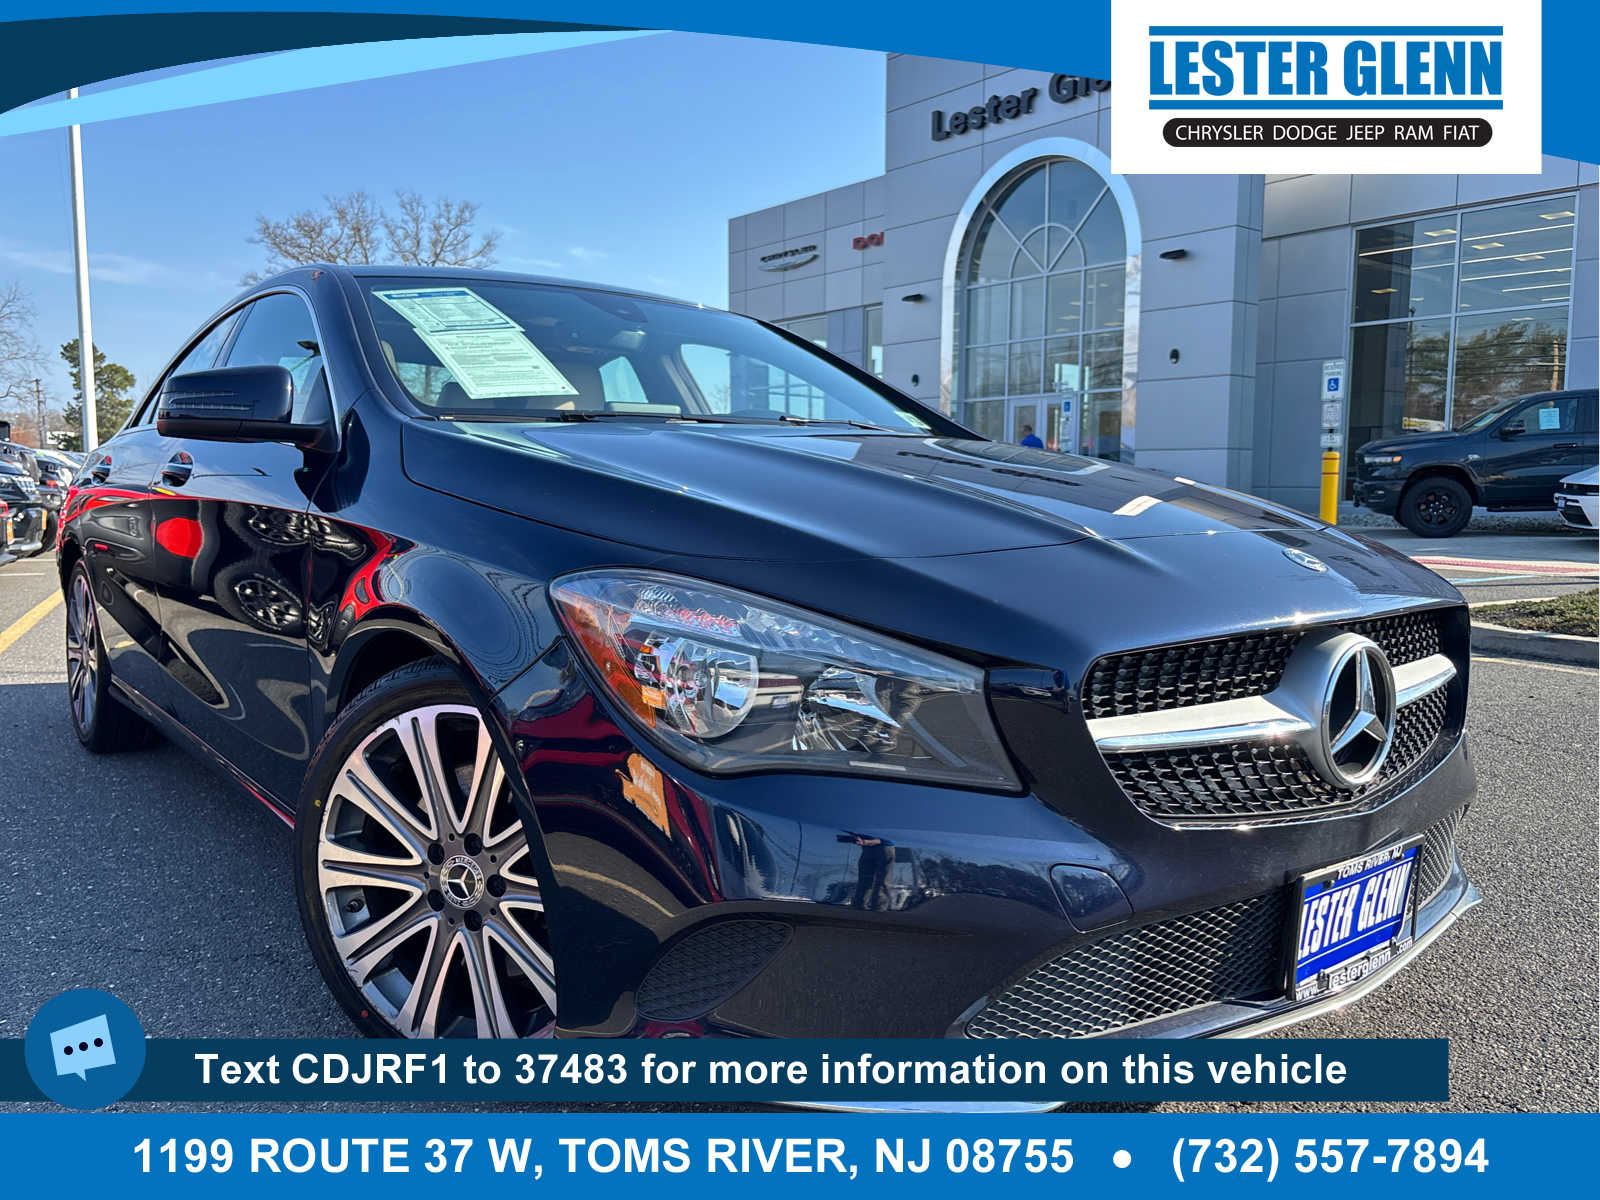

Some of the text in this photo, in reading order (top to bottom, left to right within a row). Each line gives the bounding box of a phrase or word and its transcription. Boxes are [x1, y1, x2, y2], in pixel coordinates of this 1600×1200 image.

[931, 87, 1039, 141] Lester
[1337, 863, 1363, 880] TOMS
[1298, 861, 1412, 960] LESTER GLENN
